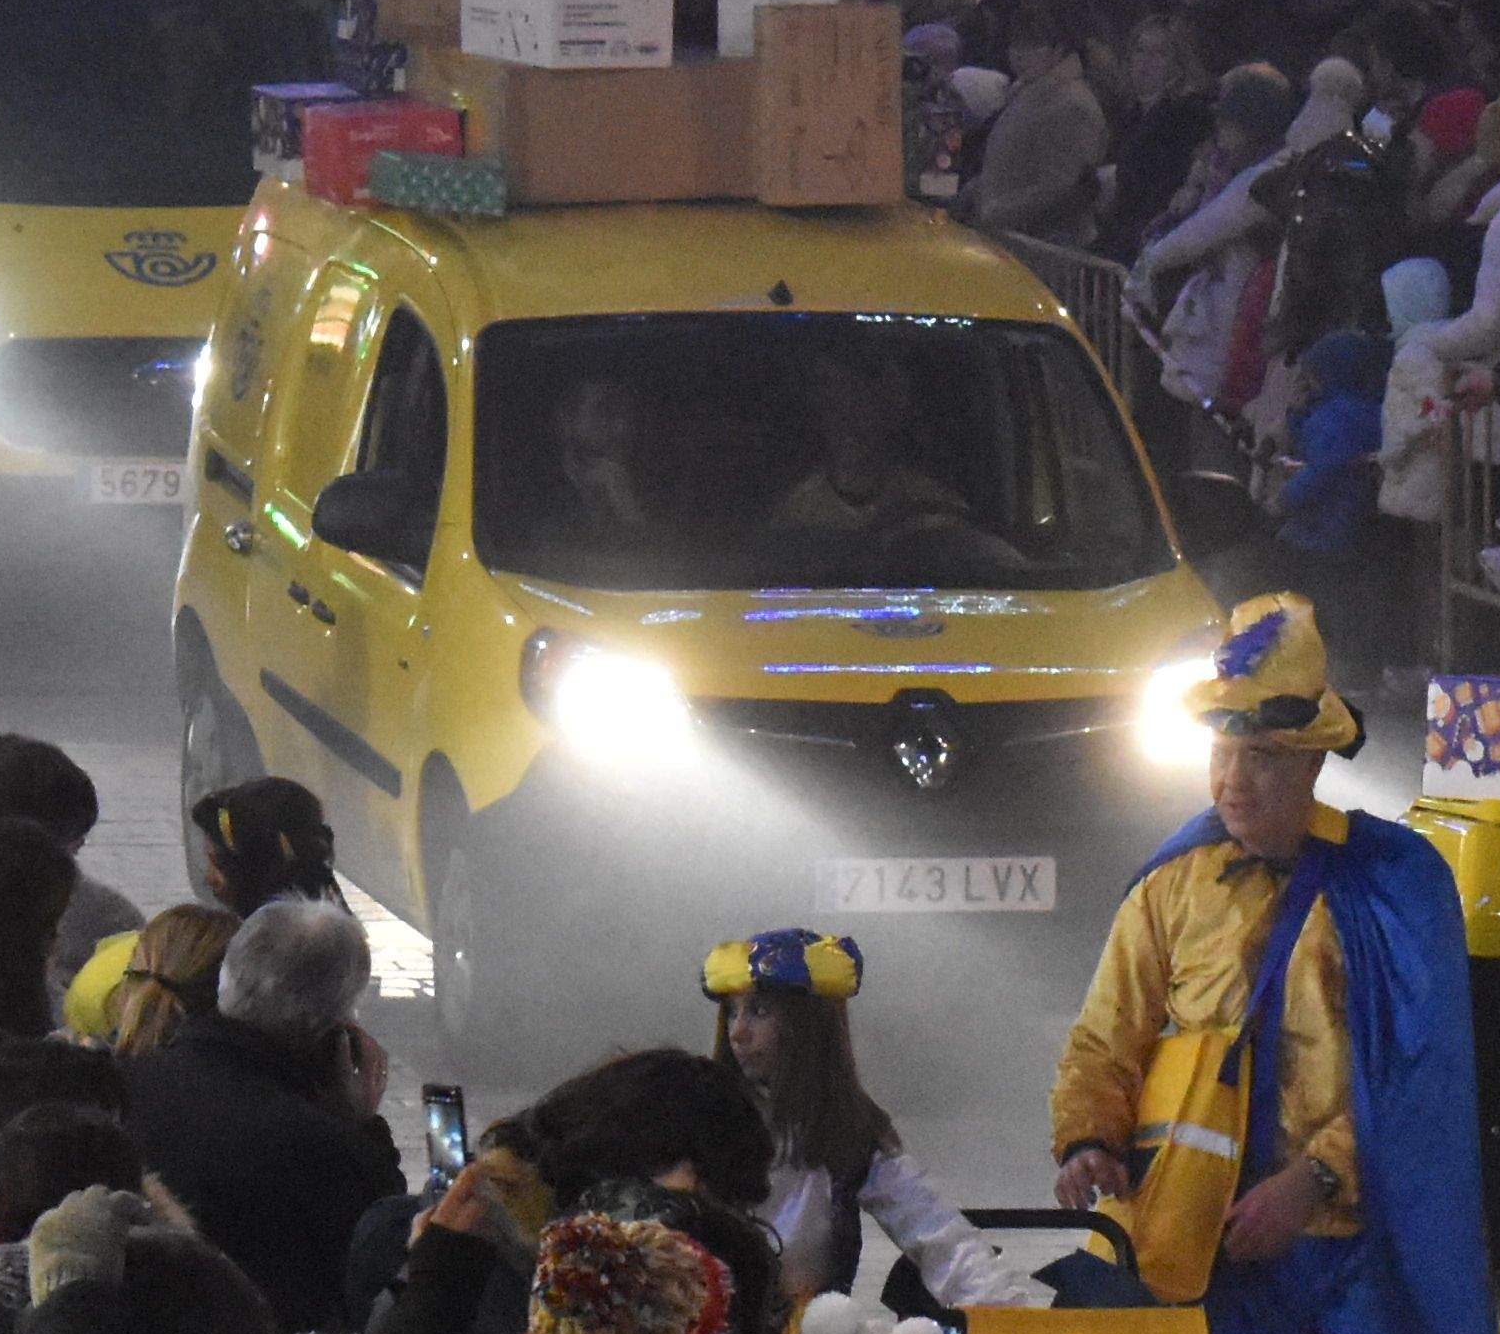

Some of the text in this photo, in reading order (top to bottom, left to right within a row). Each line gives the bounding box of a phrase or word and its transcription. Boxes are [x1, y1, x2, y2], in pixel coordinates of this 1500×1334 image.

[100, 469, 181, 499] 5679
[842, 863, 1043, 904] 7143 LVX
